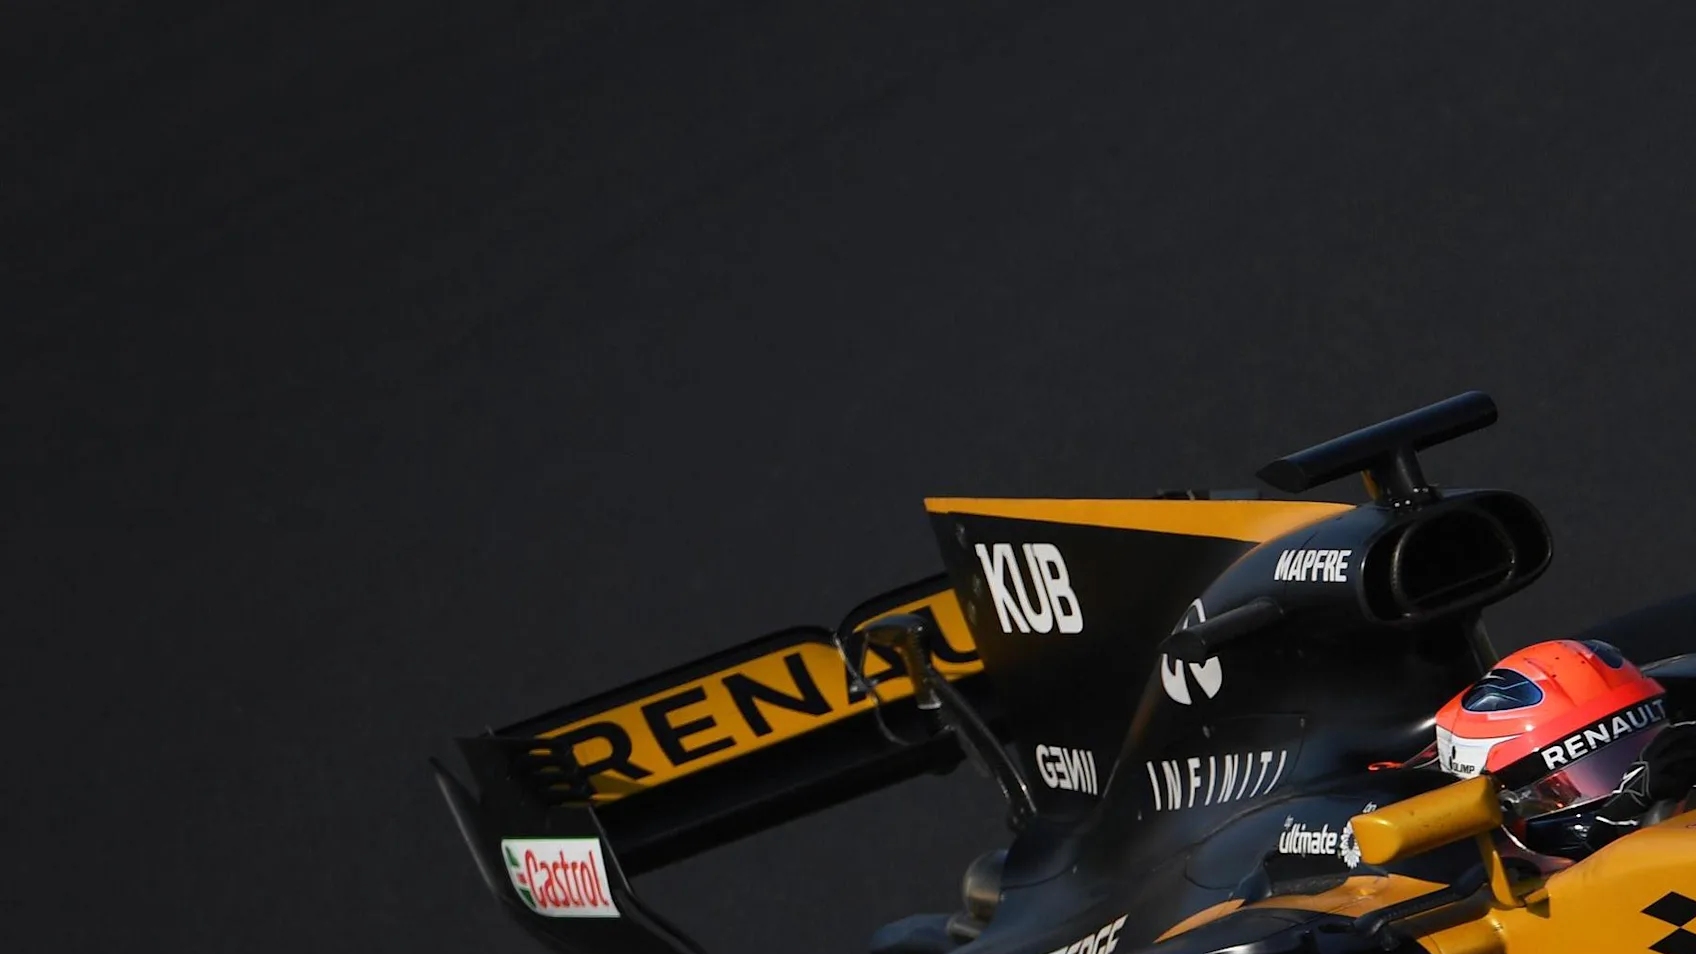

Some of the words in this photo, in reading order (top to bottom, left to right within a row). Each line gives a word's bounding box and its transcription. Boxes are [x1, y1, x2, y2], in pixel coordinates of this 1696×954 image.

[974, 542, 1084, 634] KUB
[1273, 549, 1352, 582] MAPFRE
[1541, 699, 1667, 770] RENAULT
[1146, 750, 1288, 811] INFINITI
[1279, 823, 1338, 855] ultimate
[524, 849, 610, 909] Castrol
